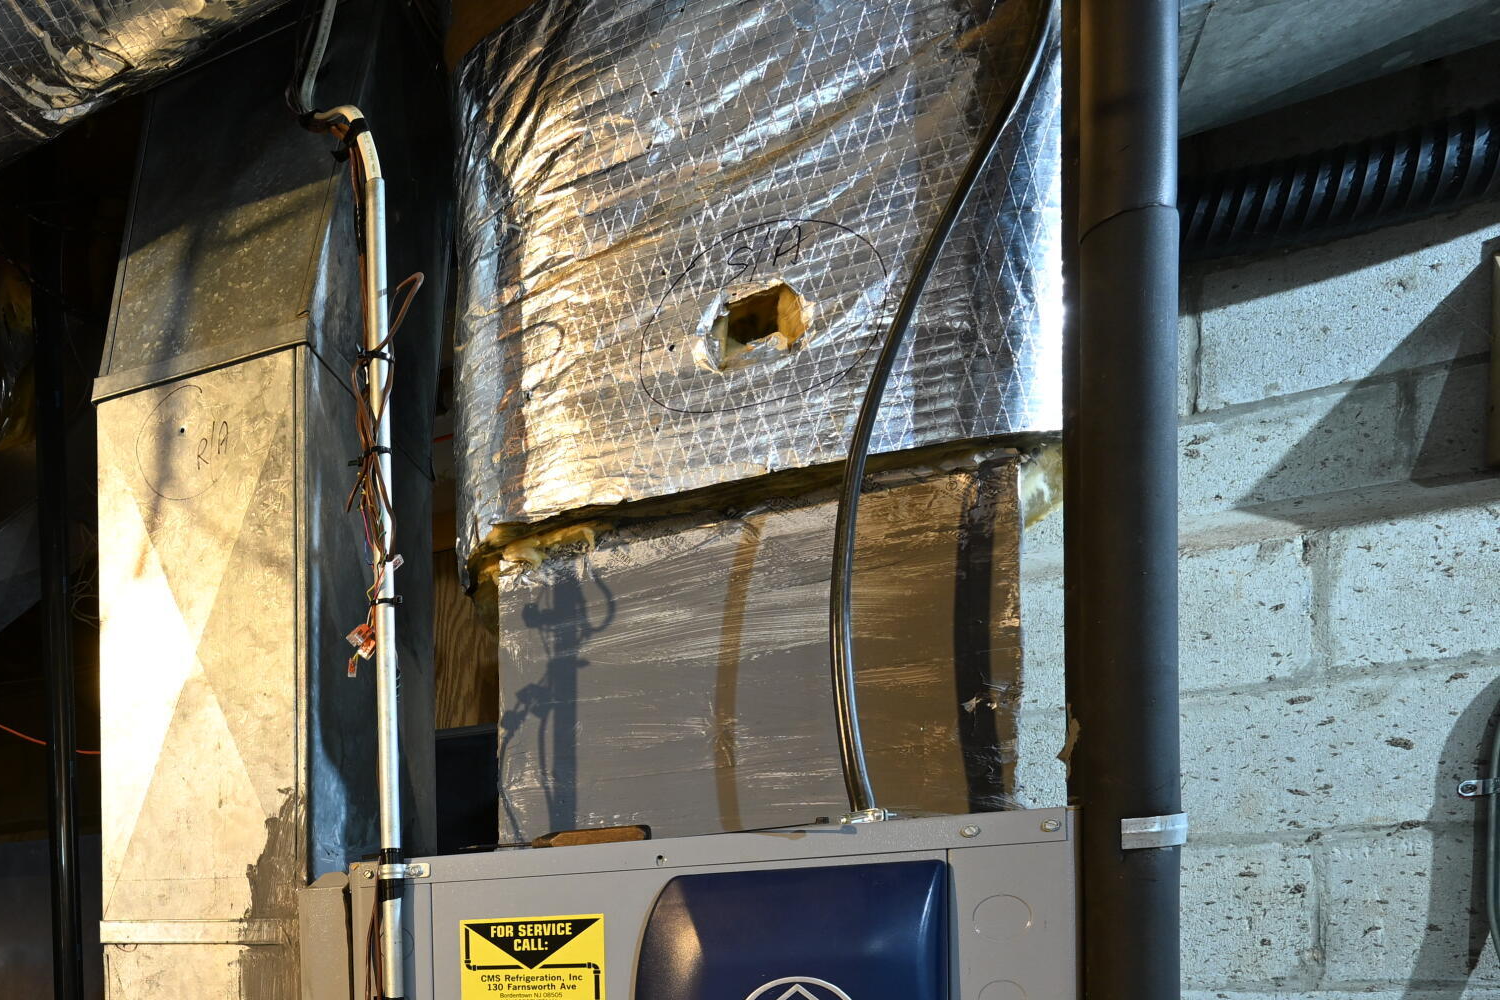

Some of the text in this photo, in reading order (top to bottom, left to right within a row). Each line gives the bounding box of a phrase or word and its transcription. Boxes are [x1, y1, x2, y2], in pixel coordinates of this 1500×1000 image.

[197, 420, 228, 470] R/A
[490, 922, 573, 938] FOR SERVICE
[513, 938, 549, 951] CALL:
[480, 973, 583, 983] CMS Refrigeration, Inc
[487, 982, 577, 991] 130 Farnsworth Ave
